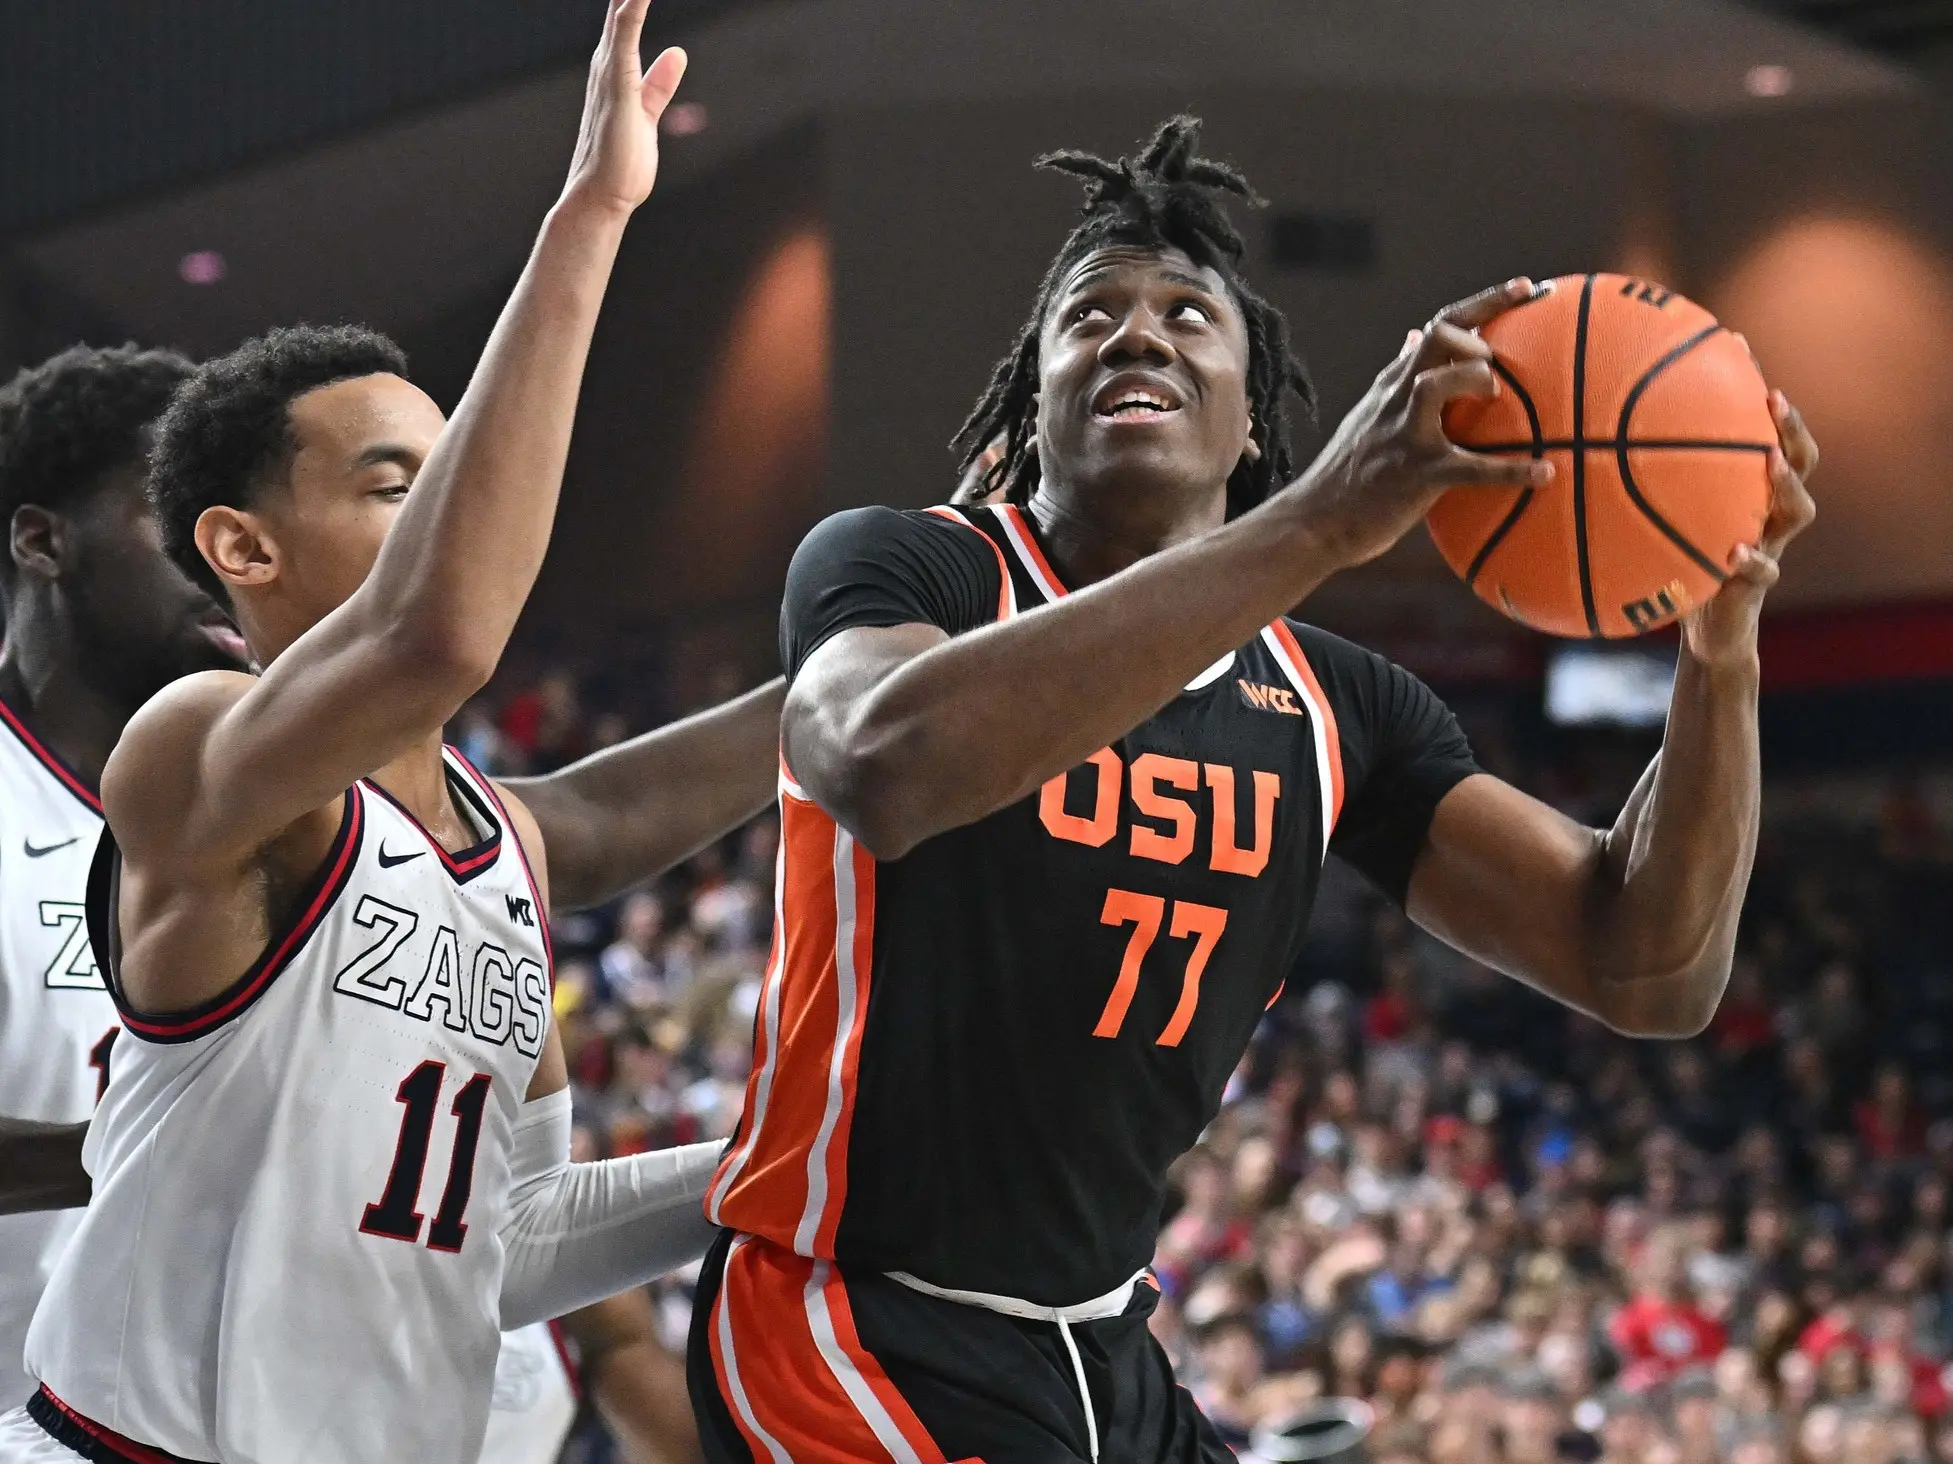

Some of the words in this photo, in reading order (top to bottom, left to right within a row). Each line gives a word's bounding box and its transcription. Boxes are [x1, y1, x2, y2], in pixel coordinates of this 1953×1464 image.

[1238, 679, 1304, 716] WCC
[1039, 746, 1280, 878] OSU
[333, 893, 546, 1060] ZAGS
[1092, 888, 1229, 1047] 77
[359, 1059, 493, 1254] 11
